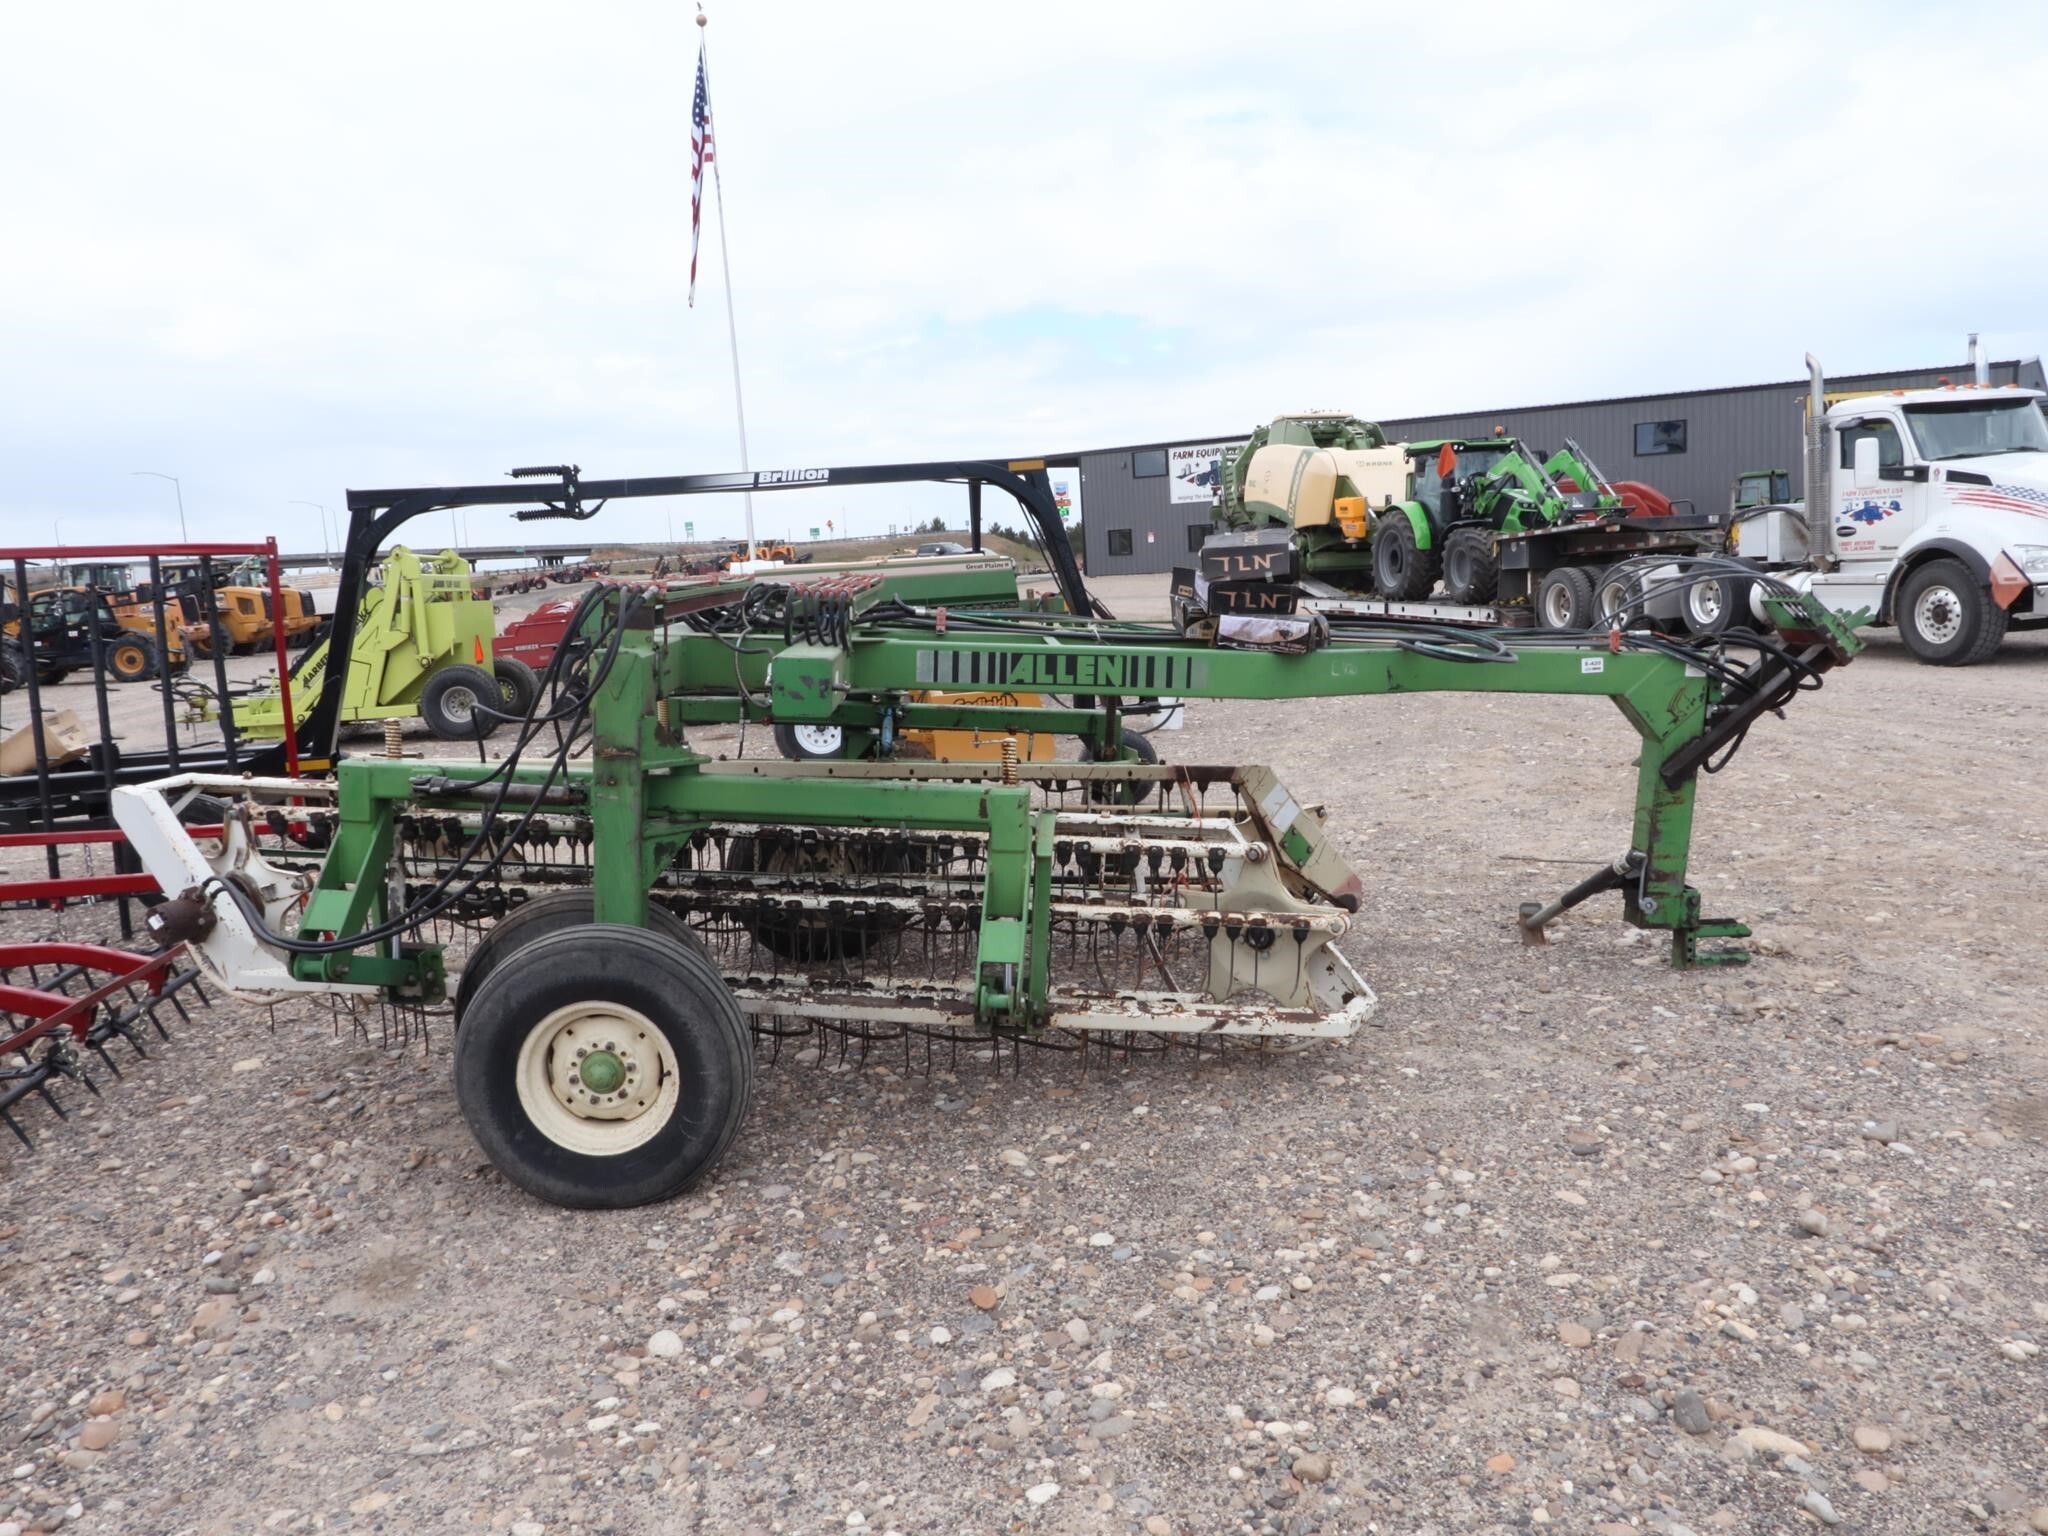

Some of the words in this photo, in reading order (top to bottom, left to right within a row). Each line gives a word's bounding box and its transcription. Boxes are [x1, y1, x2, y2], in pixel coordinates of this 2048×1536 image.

[1172, 450, 1194, 460] FARM
[1196, 447, 1220, 458] EQUIP
[758, 469, 829, 483] Brillion
[1010, 654, 1124, 687] ALLEN
